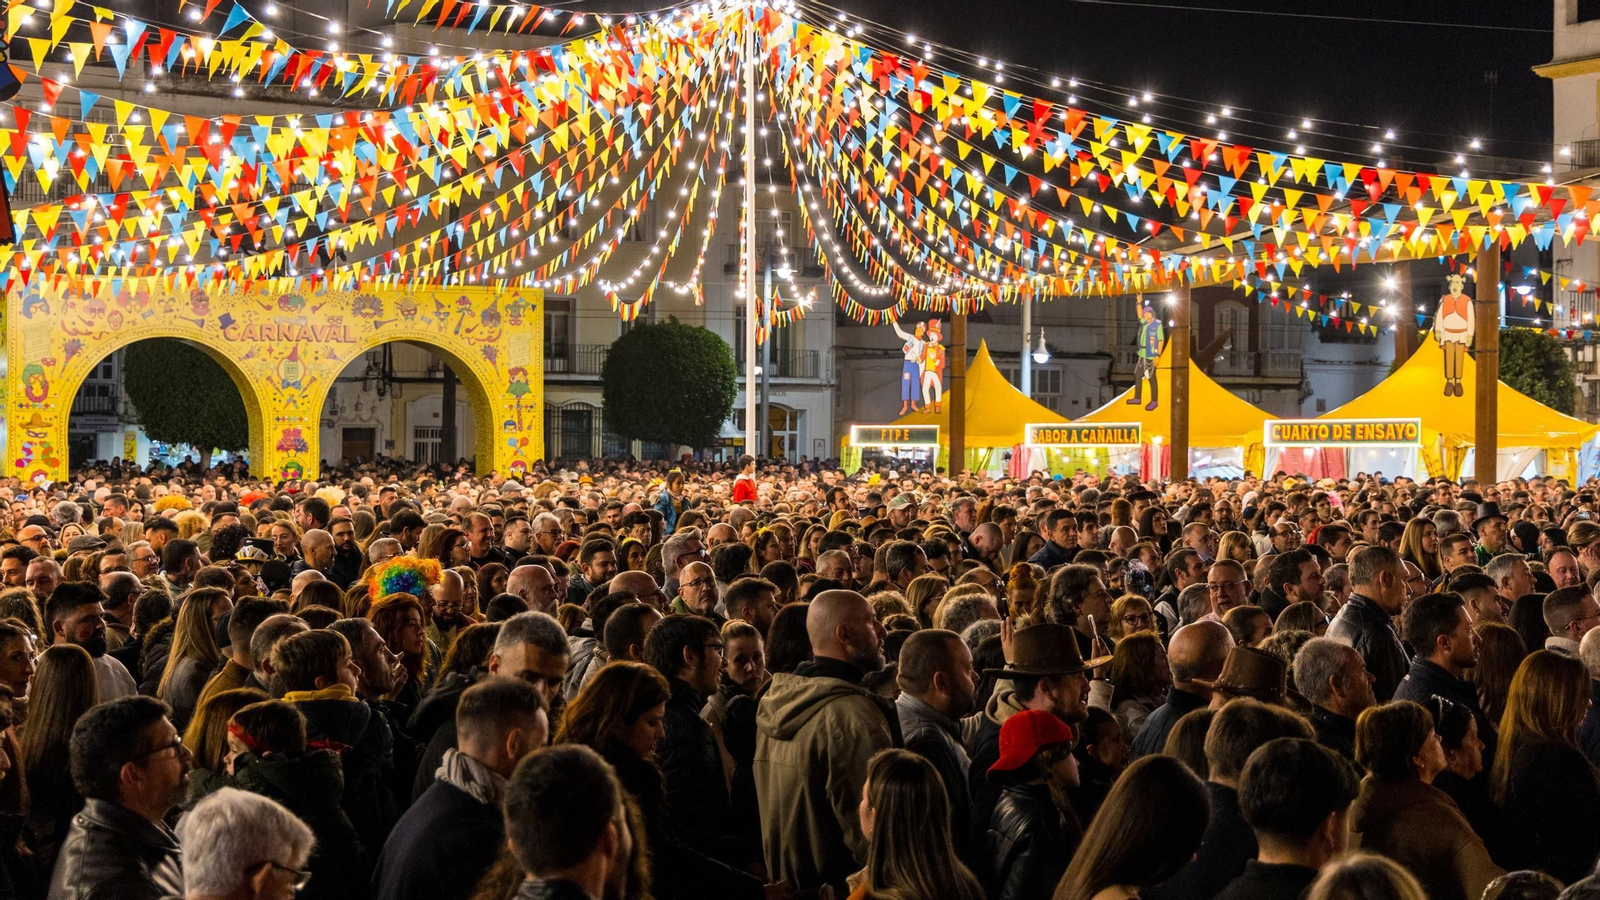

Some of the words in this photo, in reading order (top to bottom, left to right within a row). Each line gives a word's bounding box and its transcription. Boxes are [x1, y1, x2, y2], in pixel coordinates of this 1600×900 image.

[223, 323, 358, 343] CARNAVAL
[880, 428, 910, 442] FIPE
[1031, 429, 1068, 444] SABOR
[1070, 429, 1079, 444] A
[1081, 425, 1138, 443] CAÑAILLA
[1271, 424, 1329, 441] CUARTO
[1332, 424, 1352, 441] DE
[1354, 422, 1417, 441] ENSAYO
